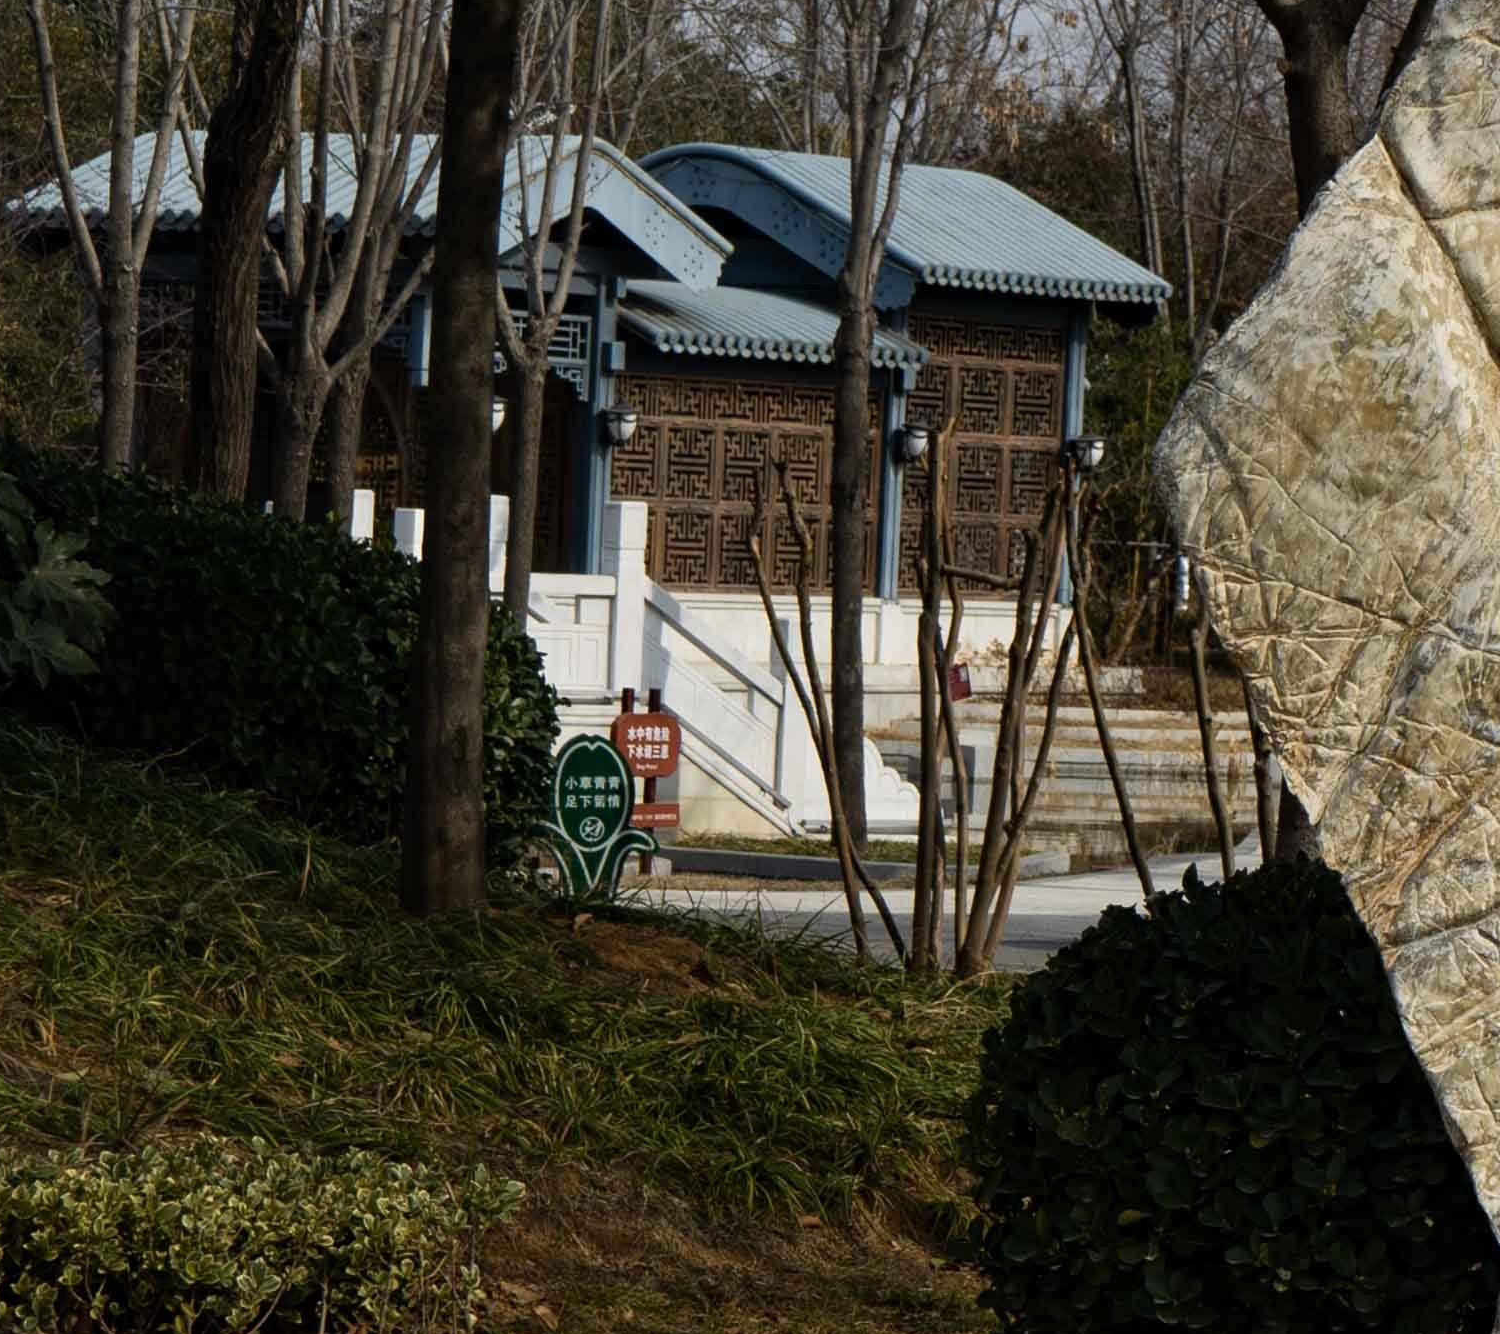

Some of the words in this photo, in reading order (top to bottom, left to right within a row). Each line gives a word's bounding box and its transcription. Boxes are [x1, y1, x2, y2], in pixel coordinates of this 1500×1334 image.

[565, 776, 621, 790] 小草青青
[565, 795, 621, 809] 足下留情
